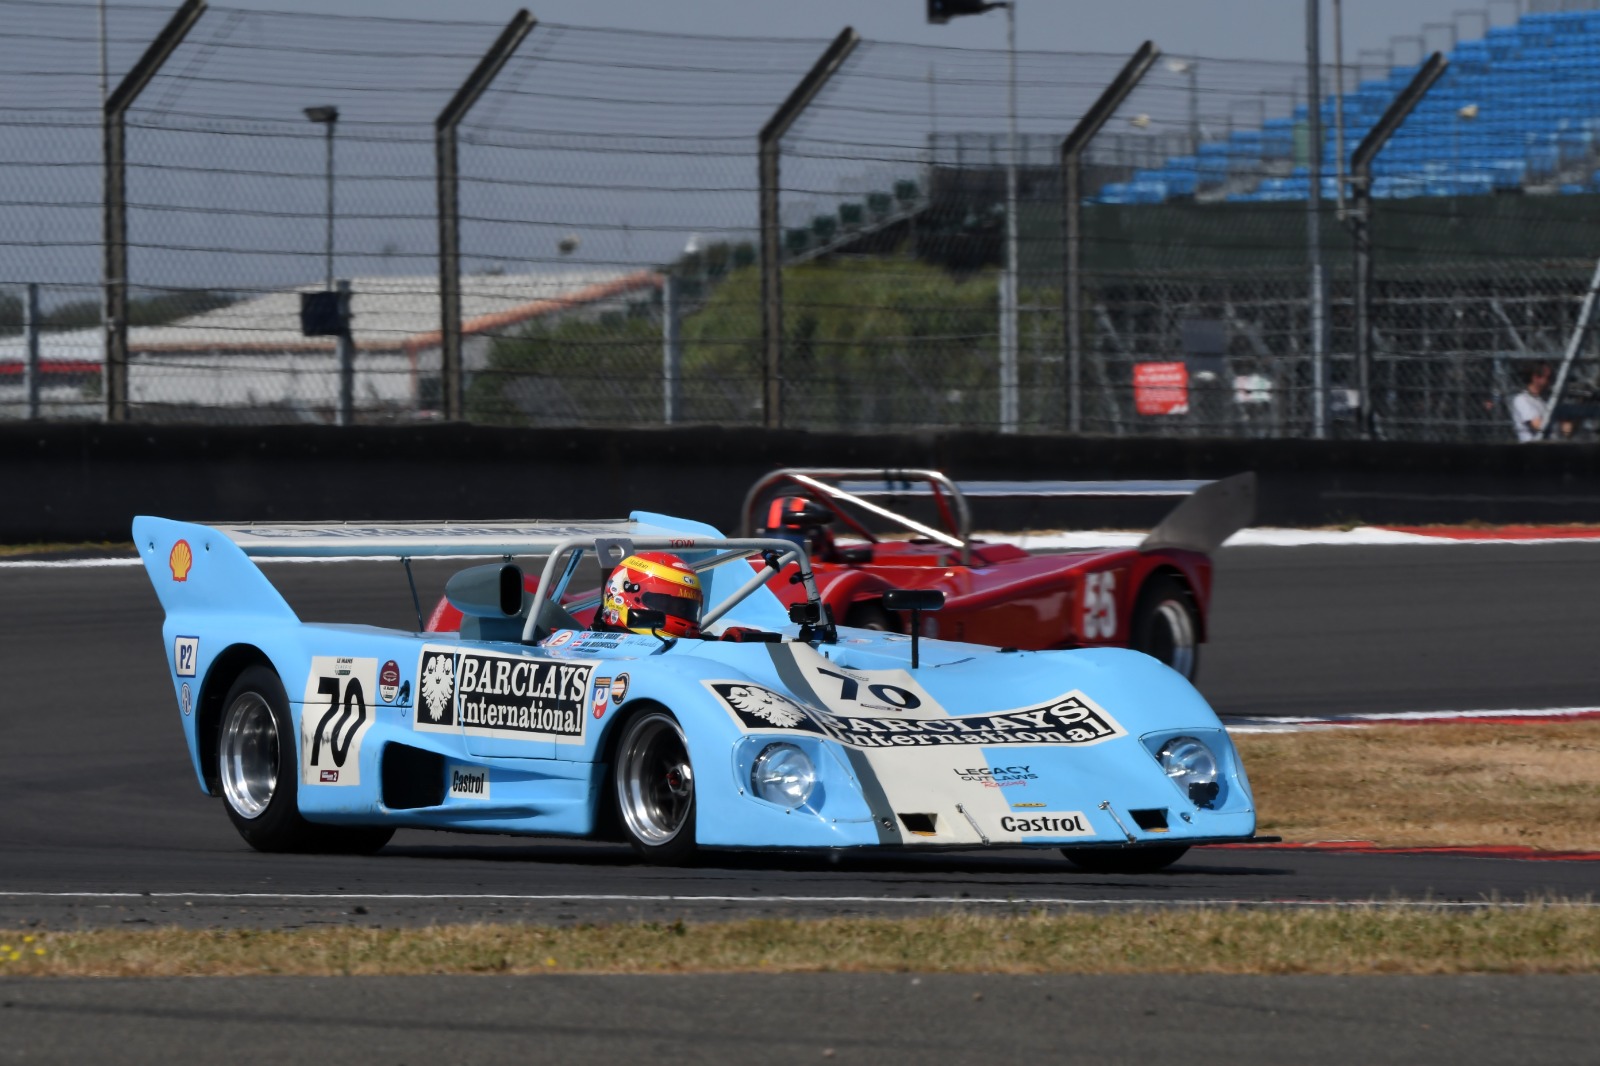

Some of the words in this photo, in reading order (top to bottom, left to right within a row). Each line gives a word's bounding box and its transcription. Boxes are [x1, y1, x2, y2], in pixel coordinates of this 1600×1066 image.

[669, 539, 695, 548] TOW
[180, 644, 193, 669] P2
[459, 658, 589, 702] BARCLAYS
[816, 667, 921, 709] 70
[310, 677, 366, 768] 70
[459, 694, 582, 733] International
[819, 700, 1090, 732] BARCLAYS
[827, 717, 1112, 746] International
[453, 770, 484, 795] Castrol
[954, 765, 1031, 777] LEGACY
[961, 773, 1039, 782] OUTLAWS
[980, 780, 1027, 788] Racing
[1000, 815, 1085, 832] Castrol
